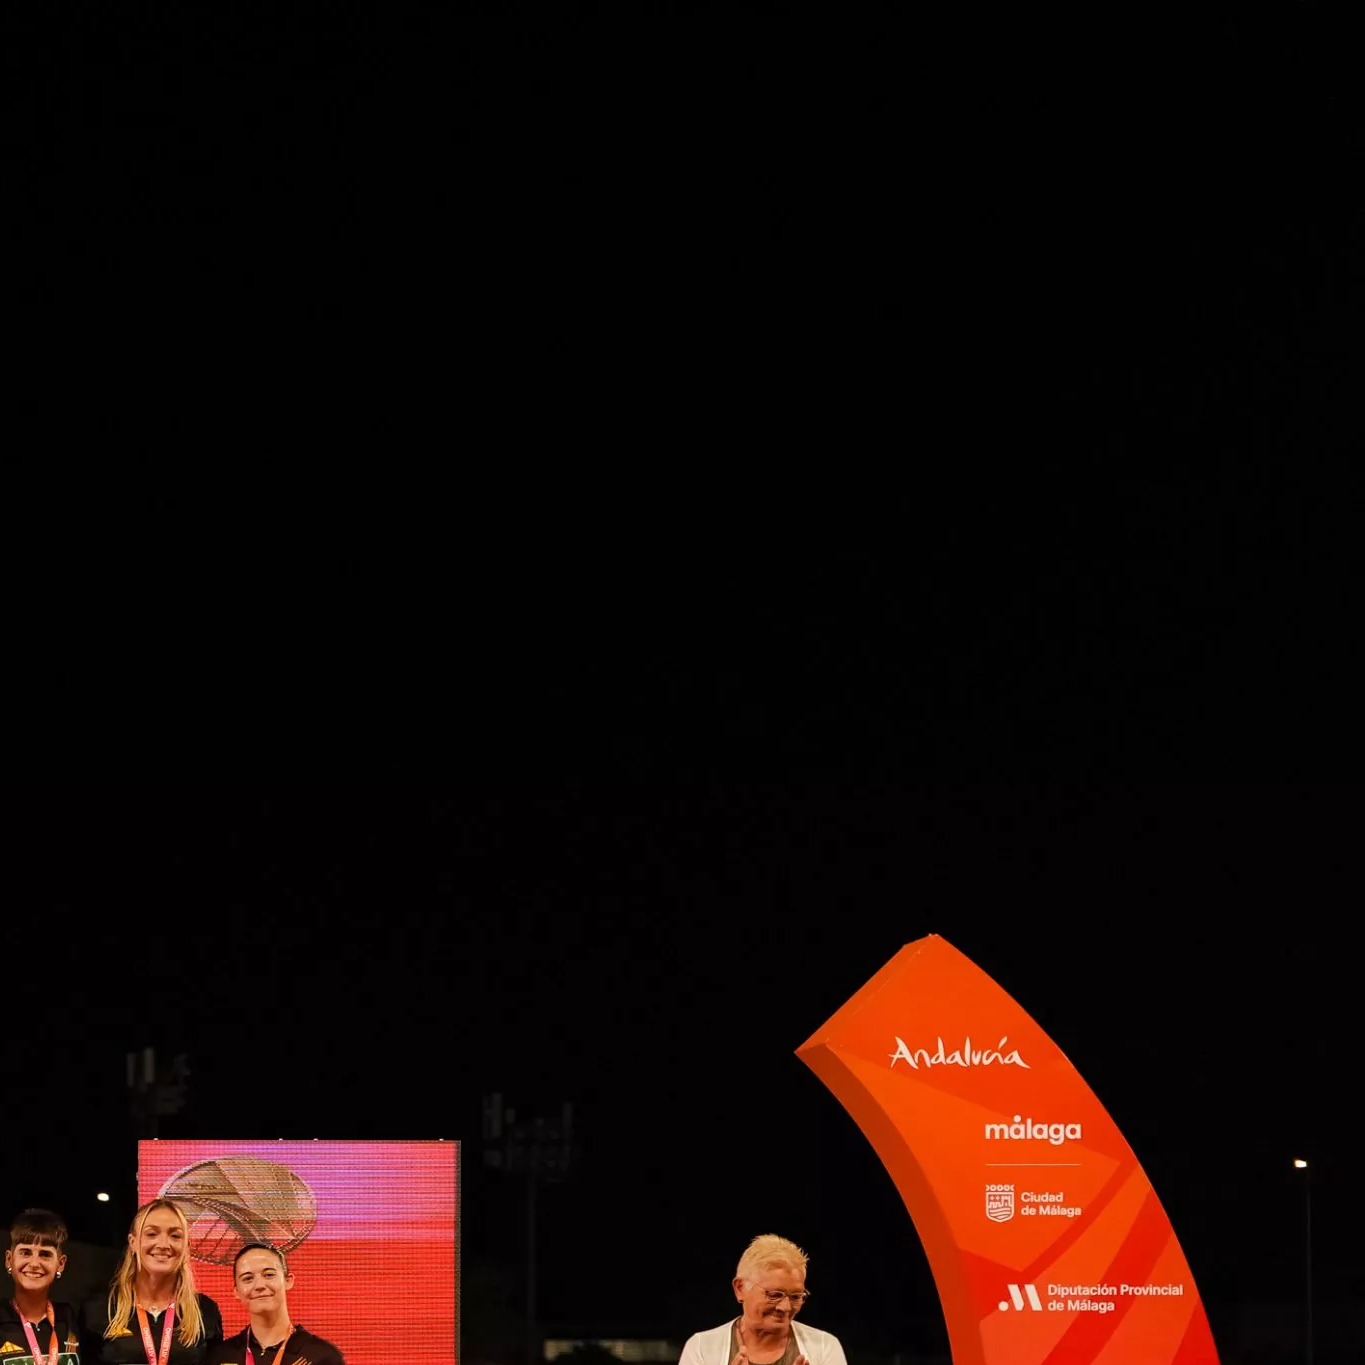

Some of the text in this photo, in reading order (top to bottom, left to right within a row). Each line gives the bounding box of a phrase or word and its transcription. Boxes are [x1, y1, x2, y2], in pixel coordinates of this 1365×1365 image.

[889, 1036, 1031, 1069] Andalucía
[1021, 1192, 1063, 1202] Ciudad
[1021, 1205, 1081, 1217] de Málaga
[1048, 1284, 1183, 1298] Diputación Provincial
[1048, 1299, 1115, 1313] de Málaga
